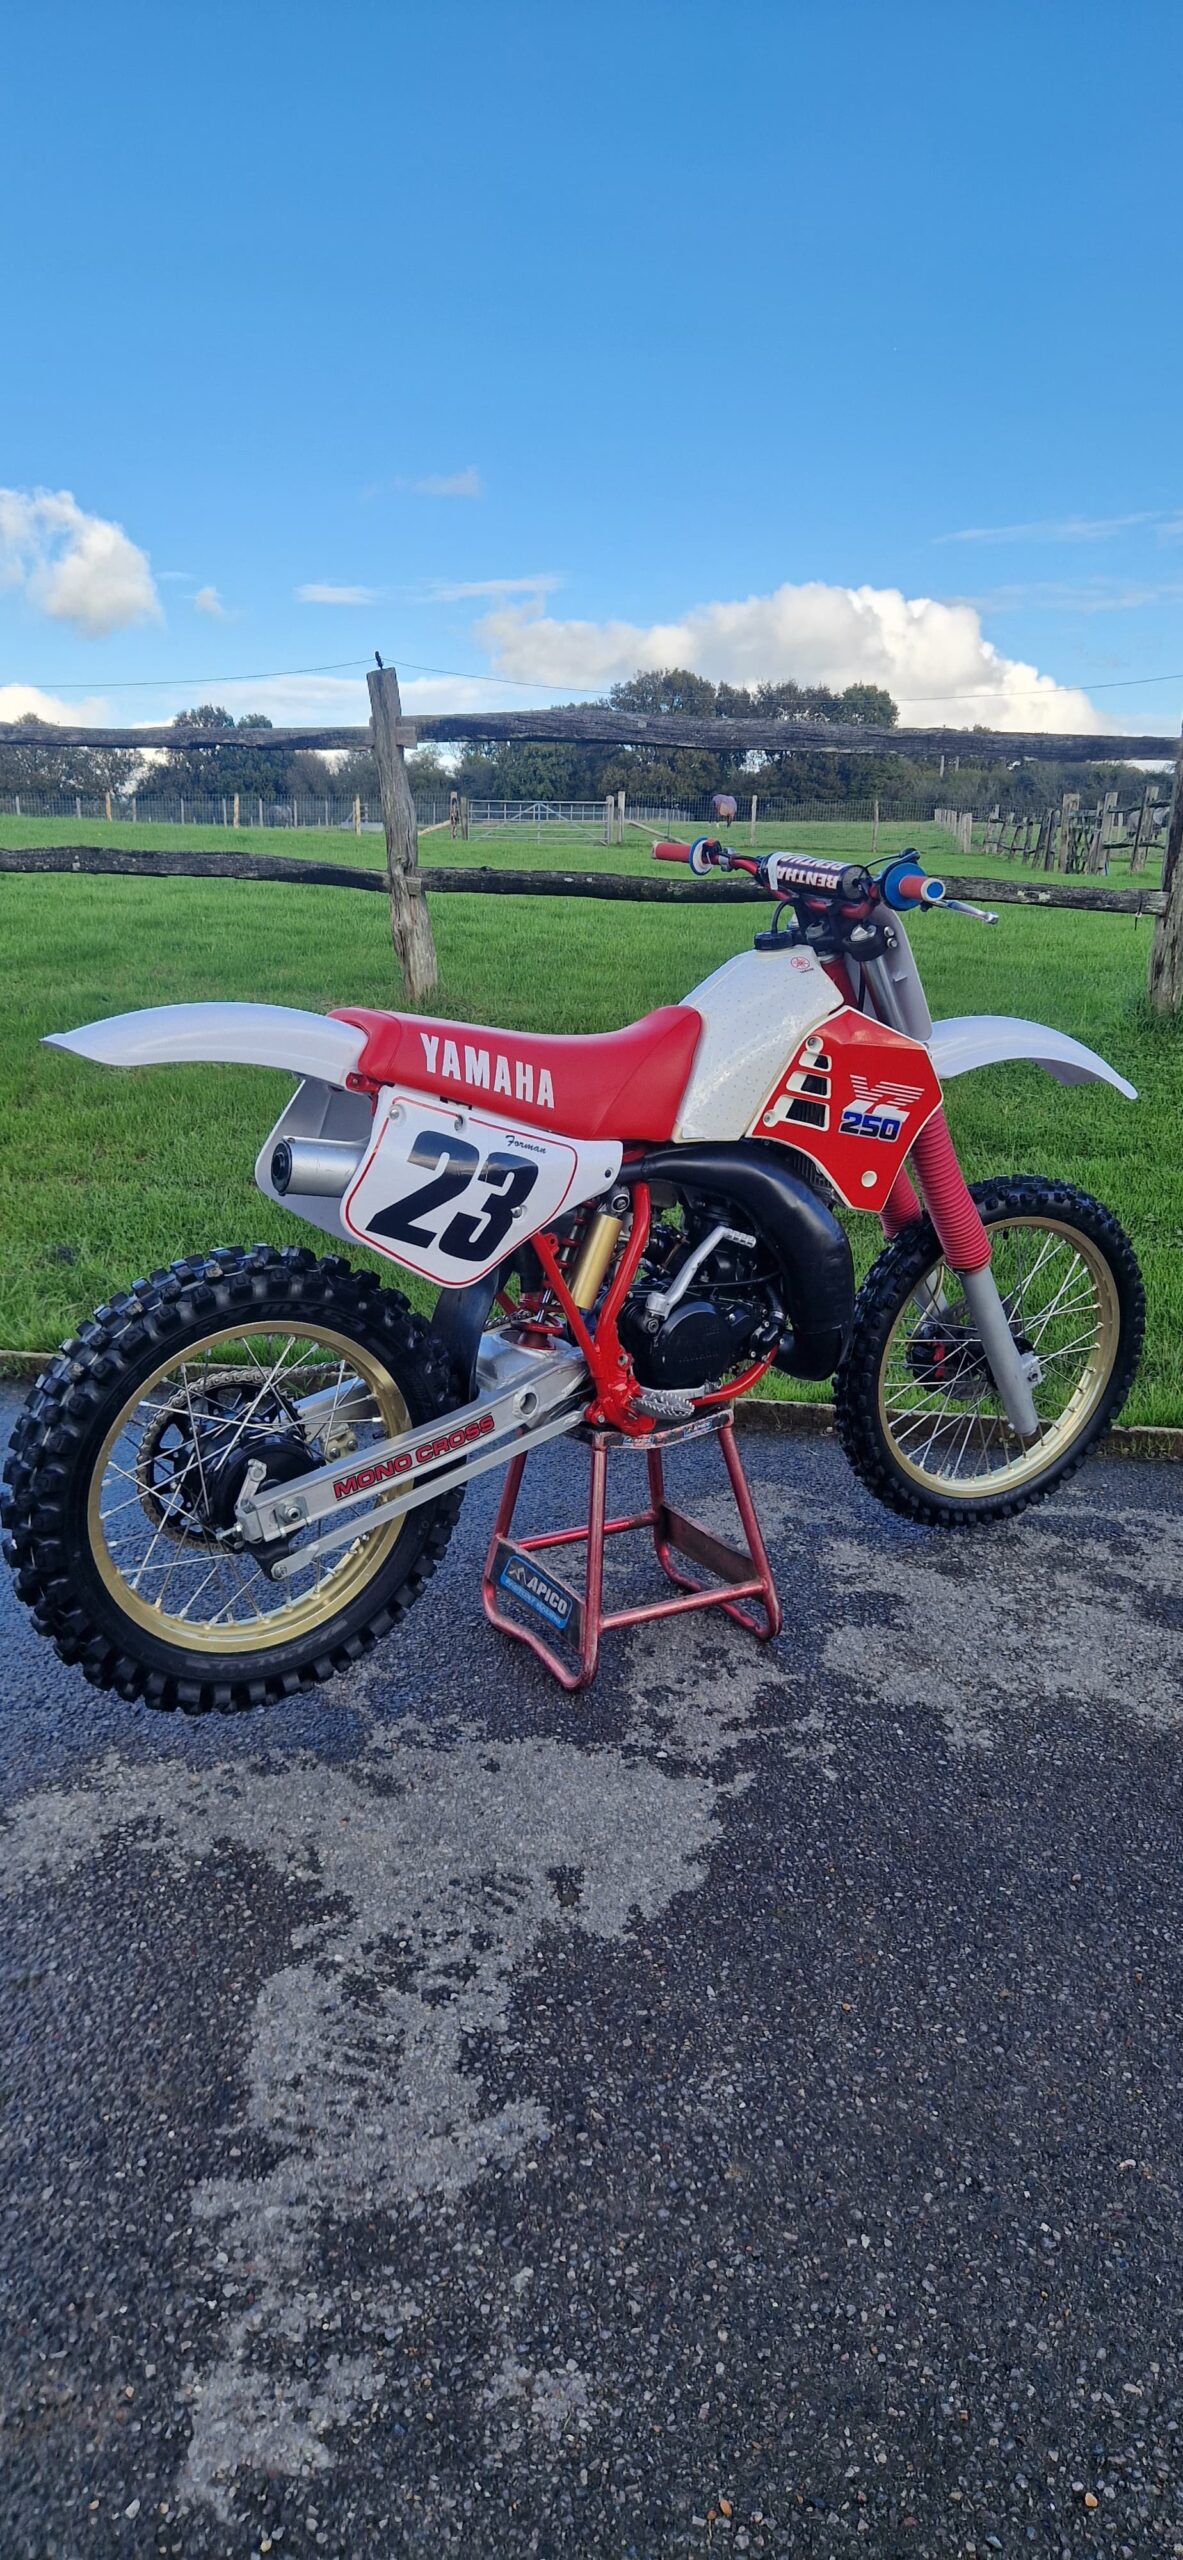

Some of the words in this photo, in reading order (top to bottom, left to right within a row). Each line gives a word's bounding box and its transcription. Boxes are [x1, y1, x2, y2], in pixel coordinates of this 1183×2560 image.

[776, 866, 840, 889] RENTHA
[420, 1032, 555, 1109] YAMAHA
[843, 1074, 925, 1122] YZ
[505, 1134, 547, 1154] Forman
[838, 1111, 902, 1143] 250
[365, 1130, 539, 1262] 23
[334, 1454, 413, 1500] MONO
[416, 1415, 495, 1464] CROSS
[527, 1577, 568, 1615] APICO
